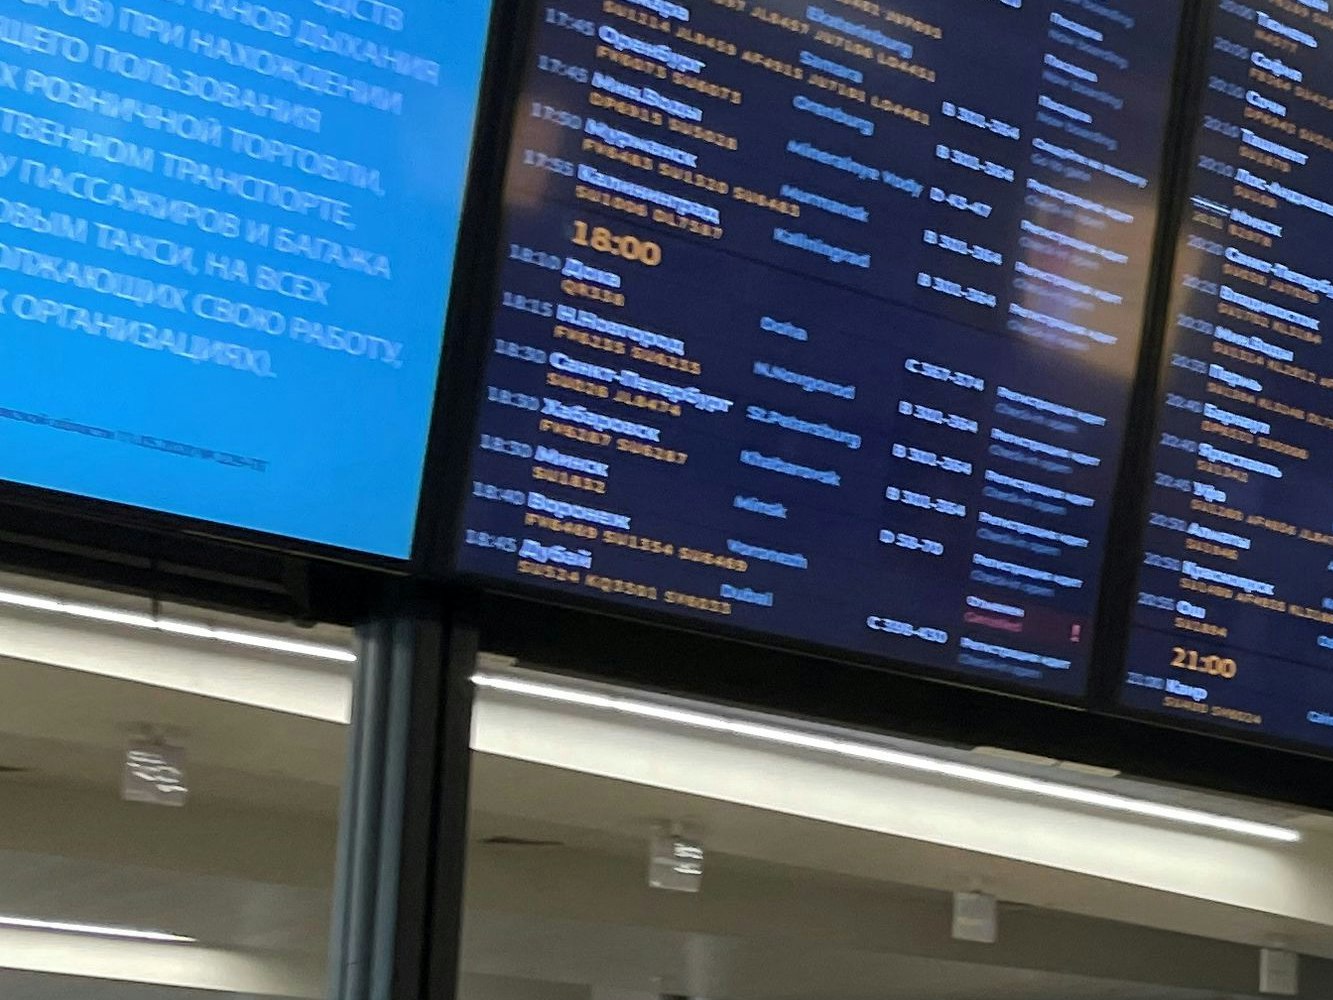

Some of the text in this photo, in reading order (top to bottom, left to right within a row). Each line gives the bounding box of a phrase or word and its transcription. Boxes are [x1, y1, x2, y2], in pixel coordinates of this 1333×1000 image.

[119, 7, 184, 48] ПРИ
[189, 29, 403, 115] НАХОЖДЕНИИ
[188, 0, 440, 86] АНОВ ДЫХАНИЯ
[93, 44, 321, 133] ПОЛЬЗОВАНИЯ
[24, 69, 222, 147] РОЗНИЧНОЙ
[227, 126, 385, 196] ТОРГОВЛИ,
[19, 158, 240, 238] ПАССАЖИРОВ
[246, 219, 270, 247] И
[273, 227, 391, 280] БАГАЖА
[160, 152, 356, 230] ТРАНСПОРТЕ,
[93, 222, 199, 275] ТАКСИ,
[204, 251, 249, 285] НА
[255, 264, 331, 305] ВСЕХ
[570, 218, 664, 269] 18:00
[192, 293, 287, 335] СВОЮ
[289, 316, 404, 369] РАБОТУ,
[1169, 645, 1237, 680] 21:00
